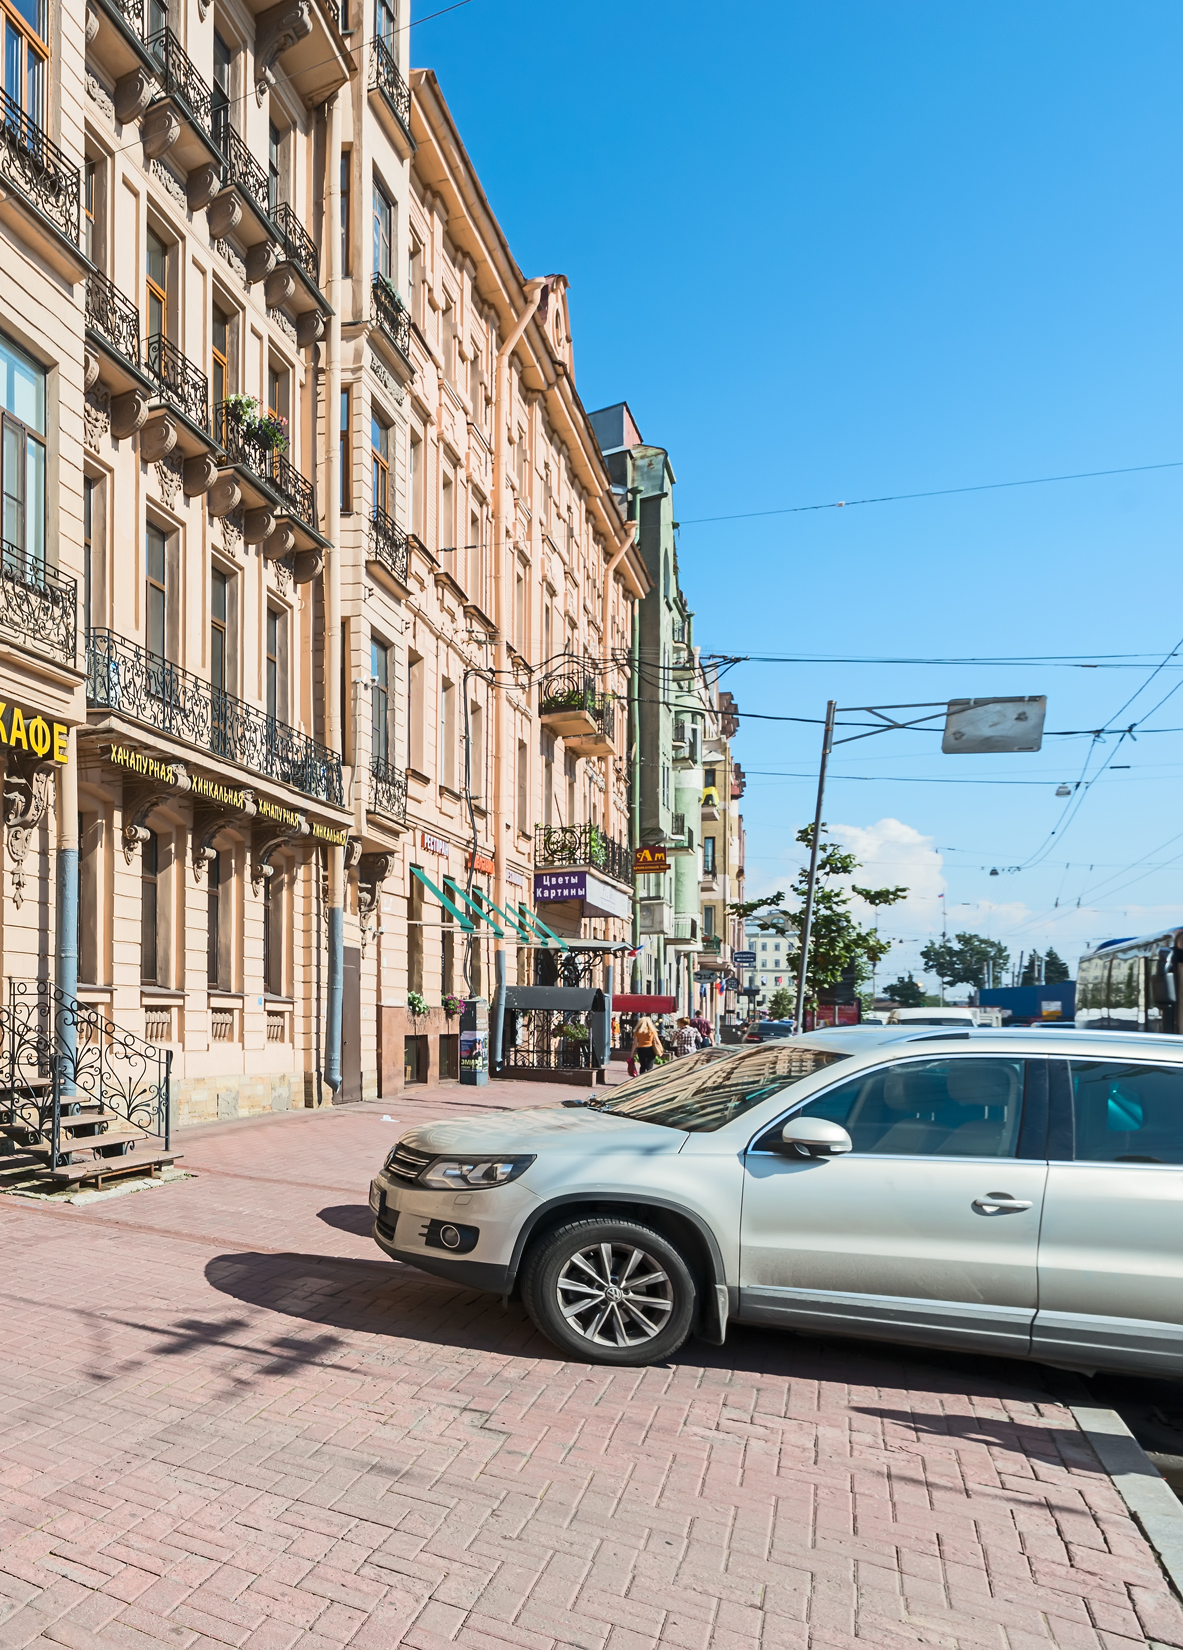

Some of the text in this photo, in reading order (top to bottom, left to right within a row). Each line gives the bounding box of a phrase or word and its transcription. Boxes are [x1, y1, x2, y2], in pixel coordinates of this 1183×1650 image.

[111, 743, 173, 785] ХАЧАПУРНАЯ
[192, 774, 244, 809] ХИНКАЛЬНАЯ
[258, 798, 299, 828] ХАЧАПУРНАЯ
[543, 875, 578, 886] Цветы
[536, 888, 585, 899] Картины
